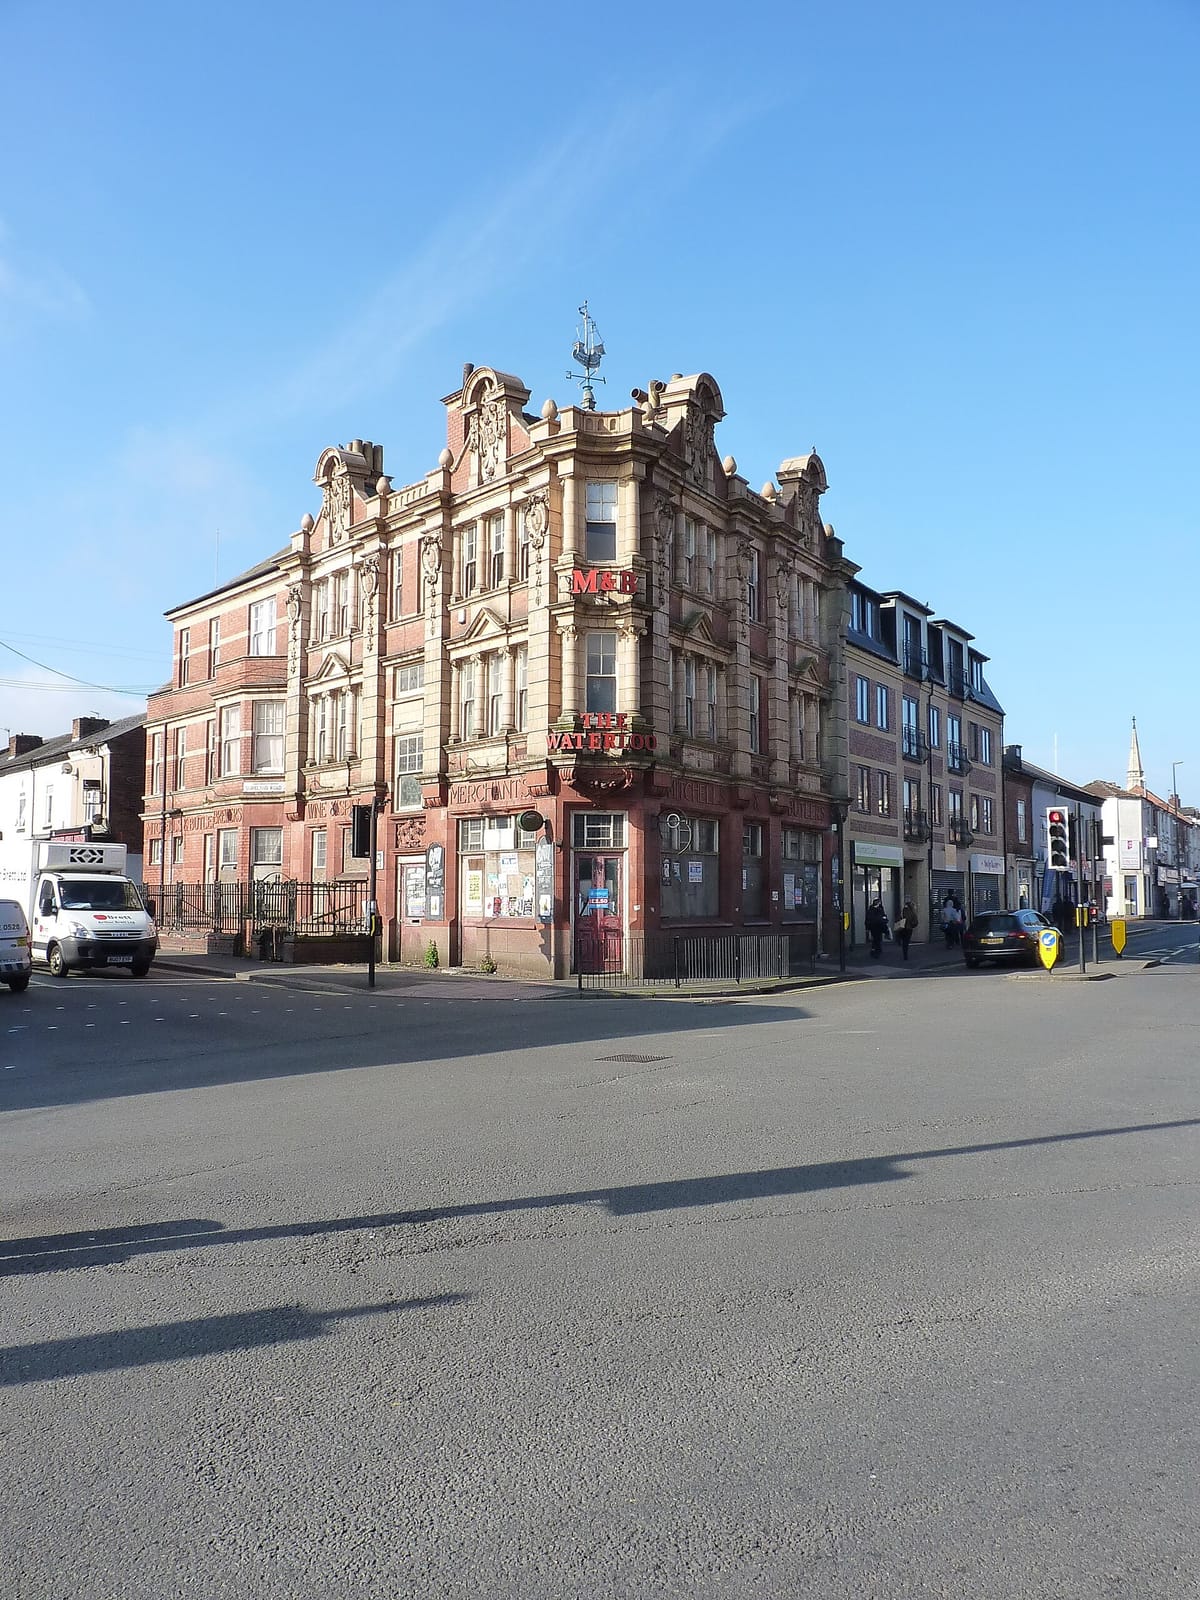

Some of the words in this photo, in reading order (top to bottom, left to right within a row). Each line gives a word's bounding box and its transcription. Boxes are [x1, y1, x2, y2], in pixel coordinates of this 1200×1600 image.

[572, 569, 638, 595] M&B
[580, 712, 628, 729] THE
[545, 732, 658, 751] WATERLOO
[307, 801, 327, 819] WINE
